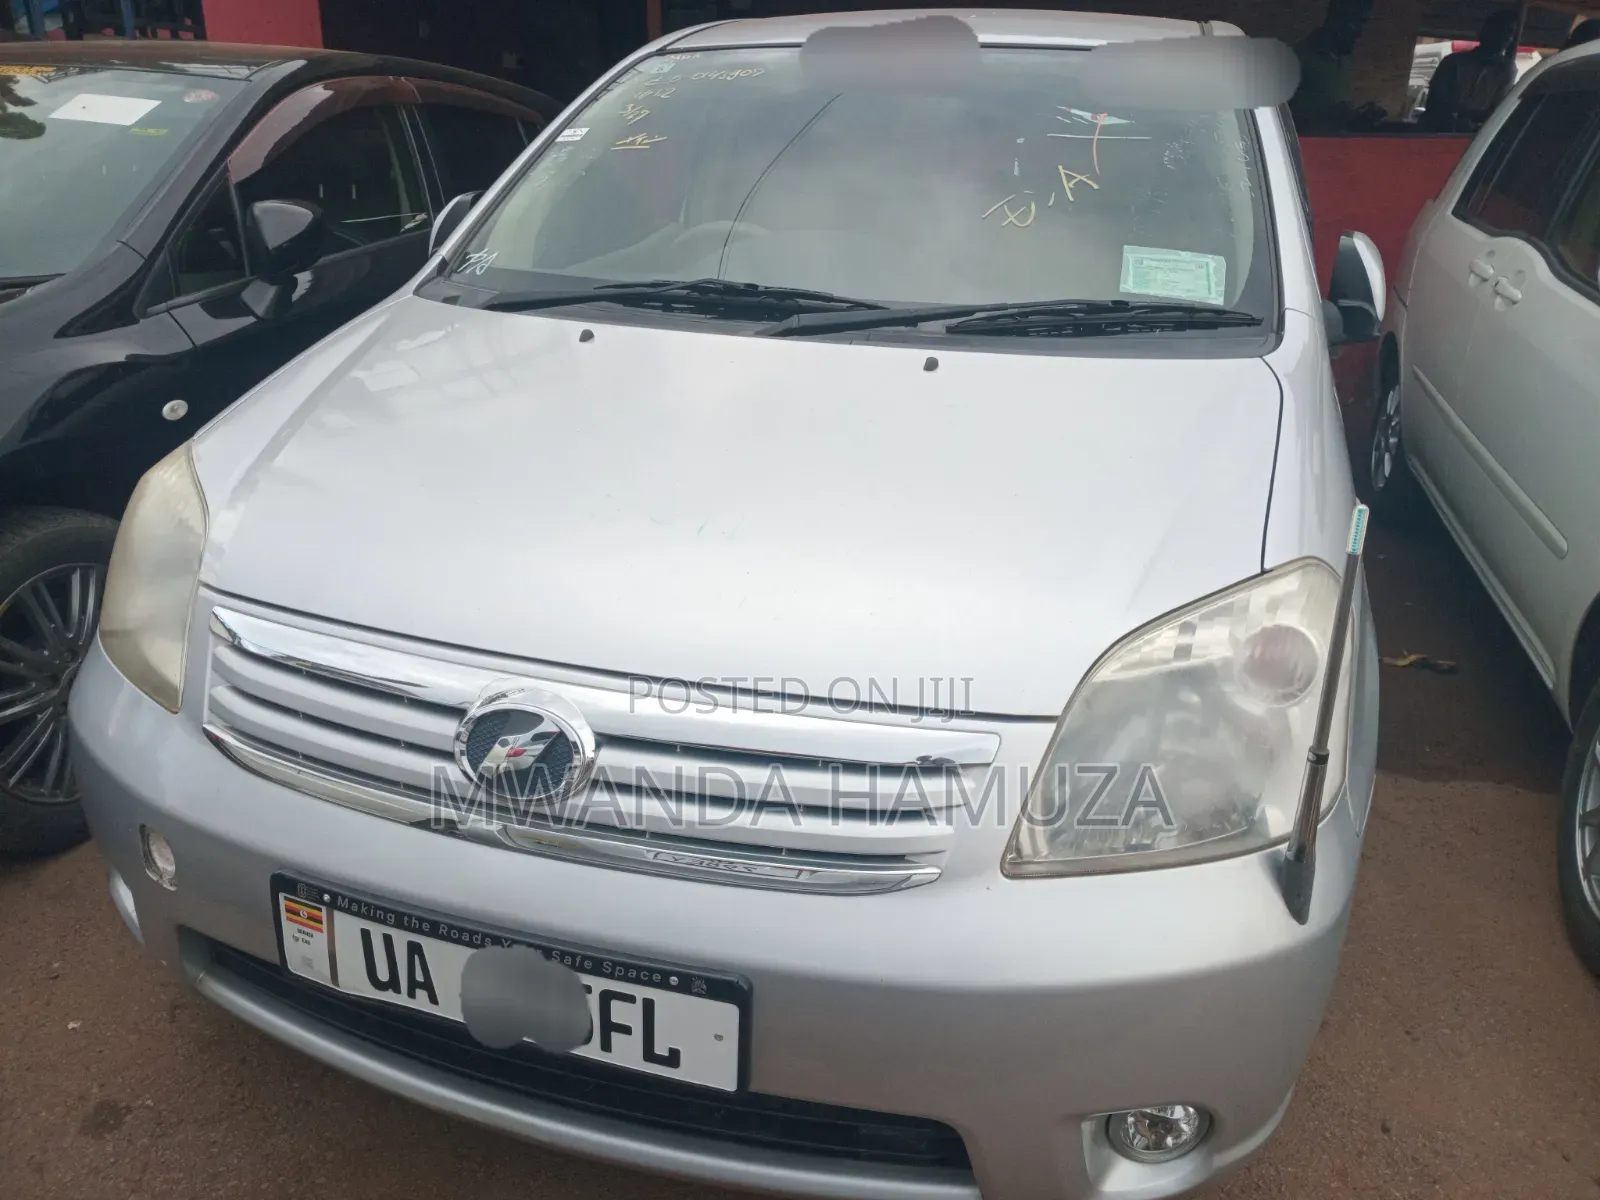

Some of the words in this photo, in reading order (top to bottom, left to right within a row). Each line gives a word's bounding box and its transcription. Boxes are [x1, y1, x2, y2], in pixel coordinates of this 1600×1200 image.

[336, 895, 396, 924] Making
[403, 914, 431, 932] the
[438, 923, 492, 947] Roads
[551, 950, 593, 970] Safe
[601, 961, 662, 983] Space
[360, 927, 440, 1006] UA
[583, 984, 681, 1069] FL
